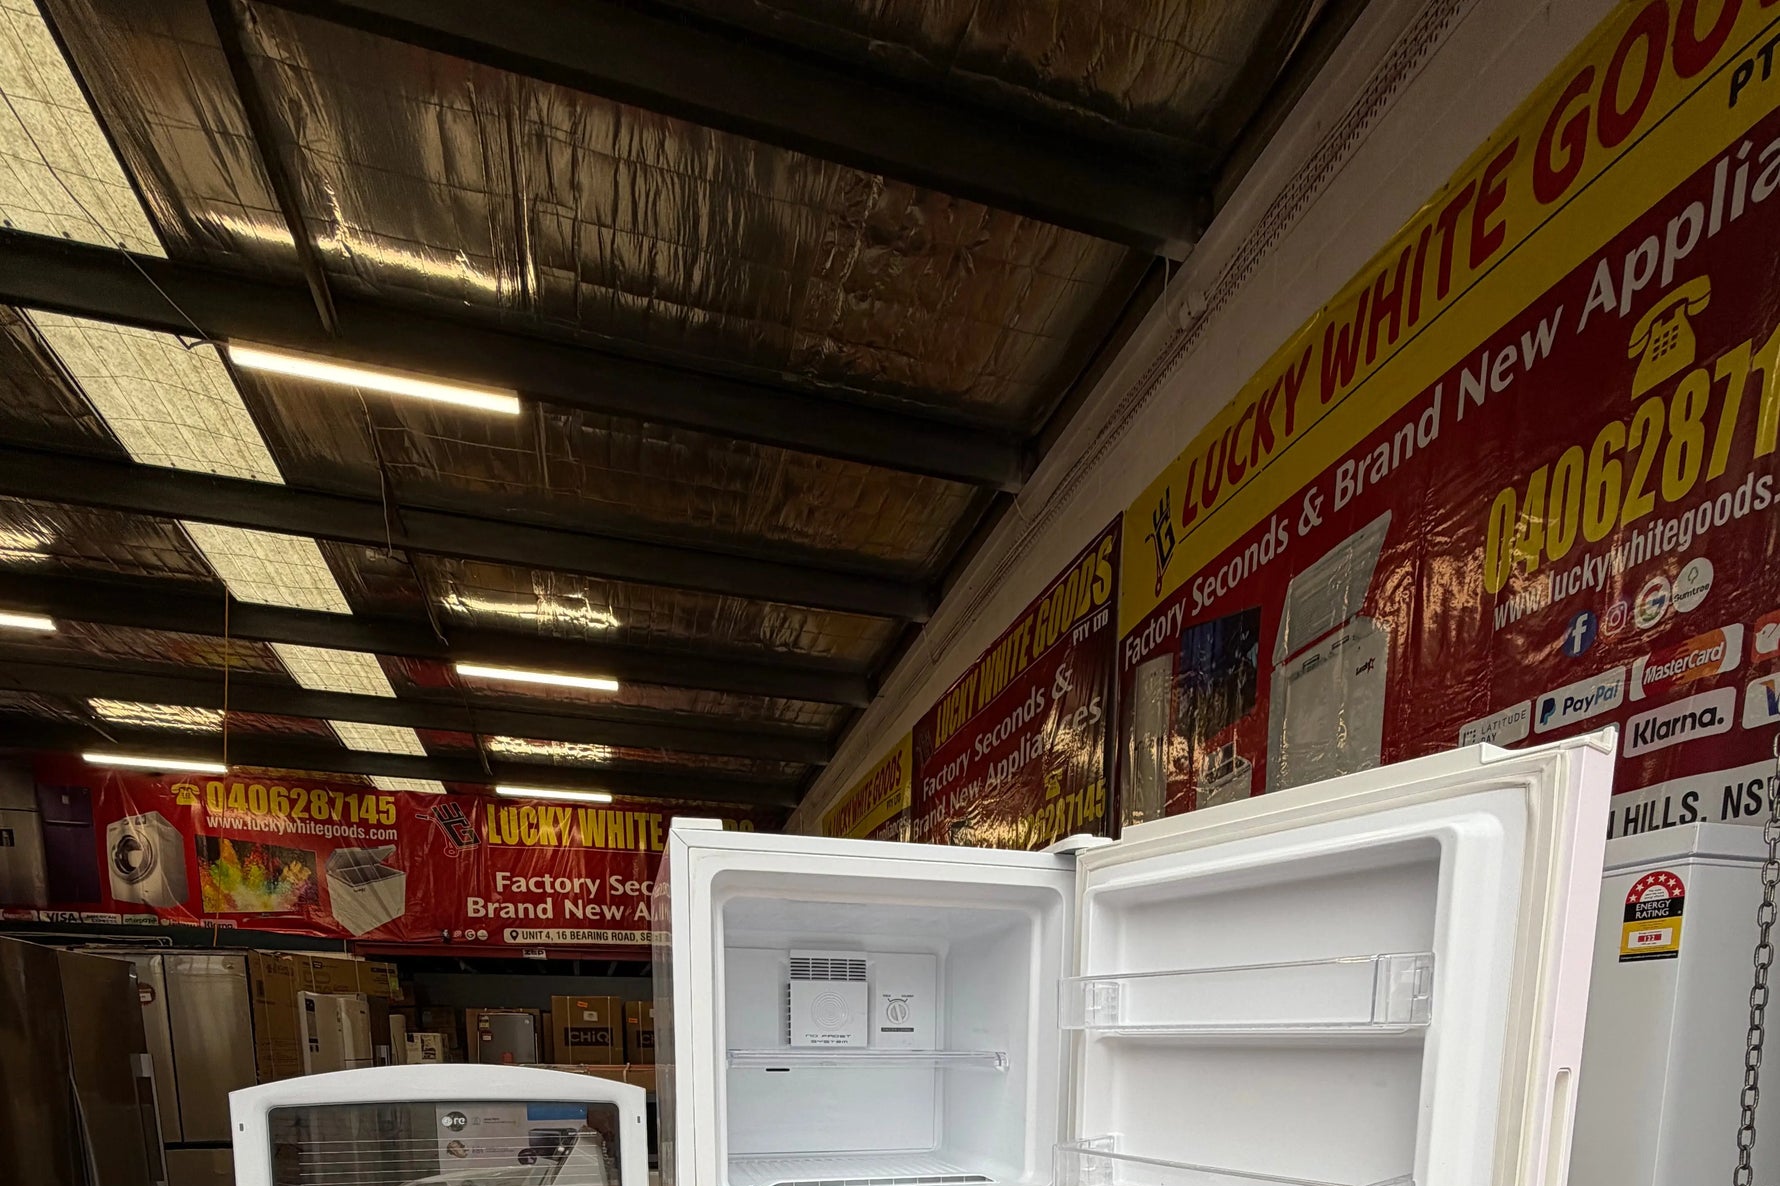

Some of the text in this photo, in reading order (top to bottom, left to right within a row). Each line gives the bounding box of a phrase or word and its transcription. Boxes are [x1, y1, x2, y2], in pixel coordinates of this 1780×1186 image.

[1182, 0, 1780, 528] LUCKY WHITE GOO
[1124, 597, 1186, 672] Factory
[1192, 515, 1289, 616] Seconds
[1298, 487, 1324, 536] &
[1334, 387, 1442, 512] Brand
[1457, 305, 1564, 420] New
[935, 535, 1112, 748] LUCKY WHITE GOODS
[1072, 608, 1109, 646] PTY LTD
[1644, 641, 1725, 685] MasterCard
[1563, 680, 1619, 716] PayPal
[923, 663, 1073, 801] Factory Seconds &
[1481, 709, 1527, 735] LATITUDE
[873, 749, 902, 805] GOODS
[206, 781, 397, 826] 0406287145
[913, 797, 946, 840] Brand
[949, 777, 981, 813] New
[206, 815, 398, 841] www.luckywhitegoods.com
[487, 803, 666, 851] LUCKY WHITE
[495, 871, 600, 899] Factory
[46, 912, 78, 923] VISA
[467, 897, 553, 919] Brand
[564, 899, 625, 921] New
[1635, 899, 1671, 911] ENERGY
[1635, 908, 1669, 919] RATING
[521, 931, 544, 940] UNIT
[545, 932, 554, 942] 4,
[556, 932, 567, 941] 16
[569, 931, 609, 941] BEARING
[611, 932, 639, 942] ROAD,
[570, 1030, 609, 1043] CHiQ
